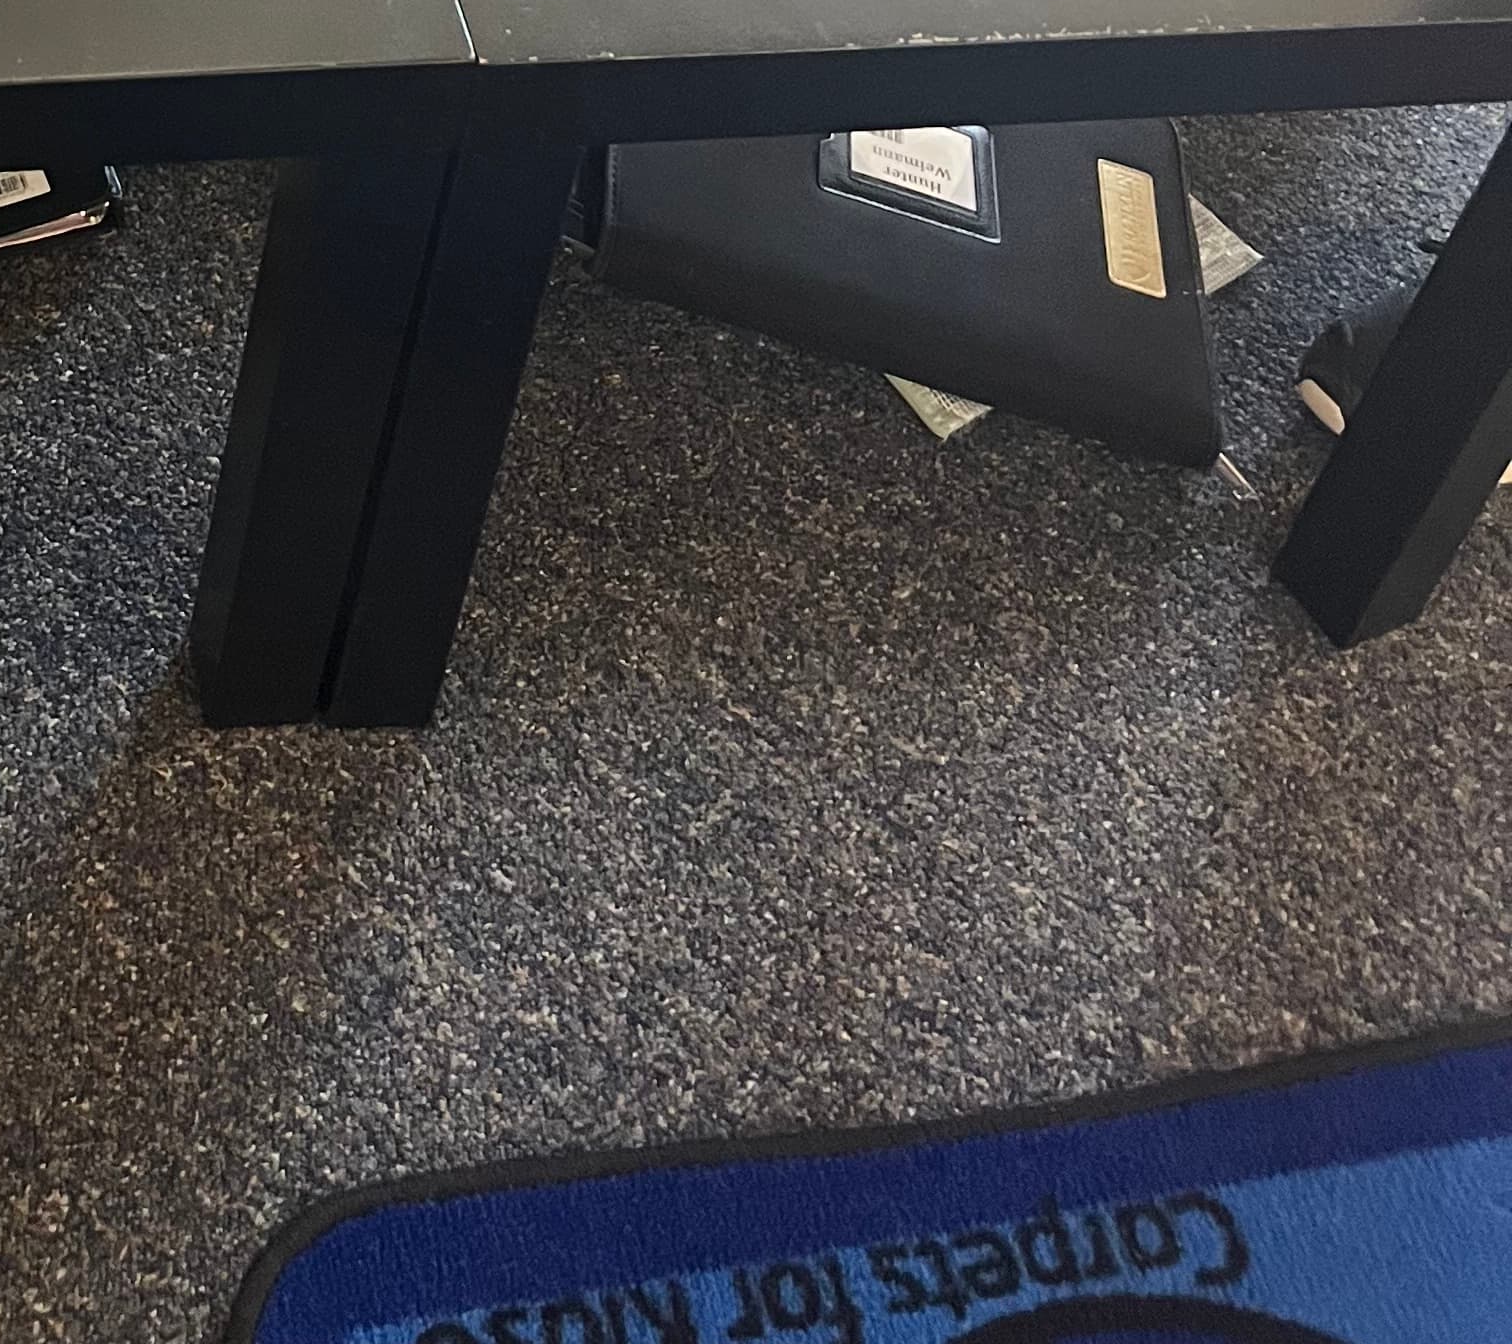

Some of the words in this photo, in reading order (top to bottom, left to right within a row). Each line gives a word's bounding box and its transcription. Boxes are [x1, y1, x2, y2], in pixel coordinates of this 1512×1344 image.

[880, 164, 942, 195] Hunter
[728, 1247, 866, 1344] for
[878, 1190, 1250, 1315] Carpets
